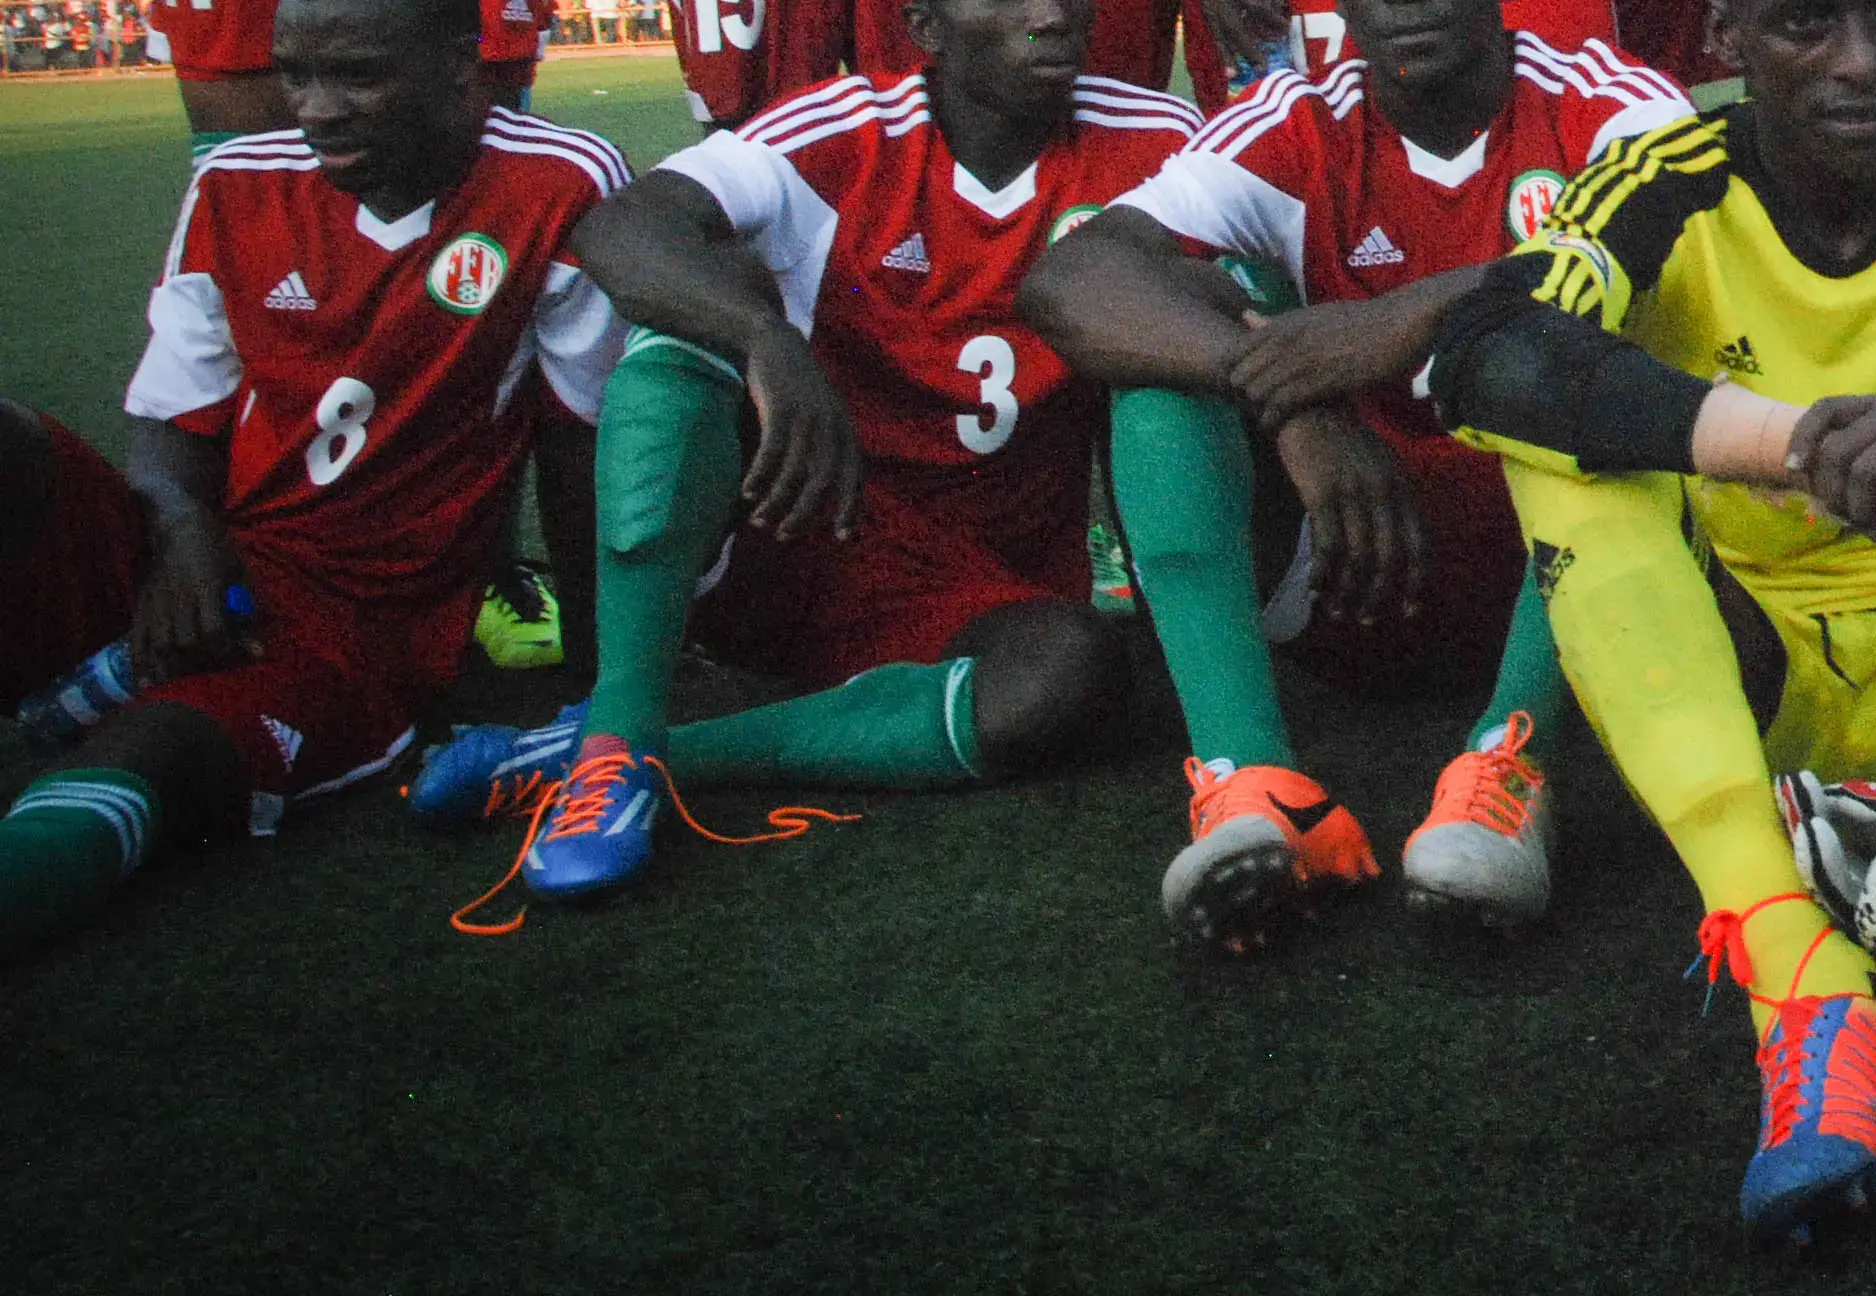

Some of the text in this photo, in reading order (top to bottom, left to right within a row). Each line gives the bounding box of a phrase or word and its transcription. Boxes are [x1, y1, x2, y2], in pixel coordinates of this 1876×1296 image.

[881, 254, 931, 273] adidas
[1346, 249, 1405, 268] adidas
[263, 294, 318, 311] adidas
[956, 334, 1019, 454] 3
[307, 376, 371, 486] 8
